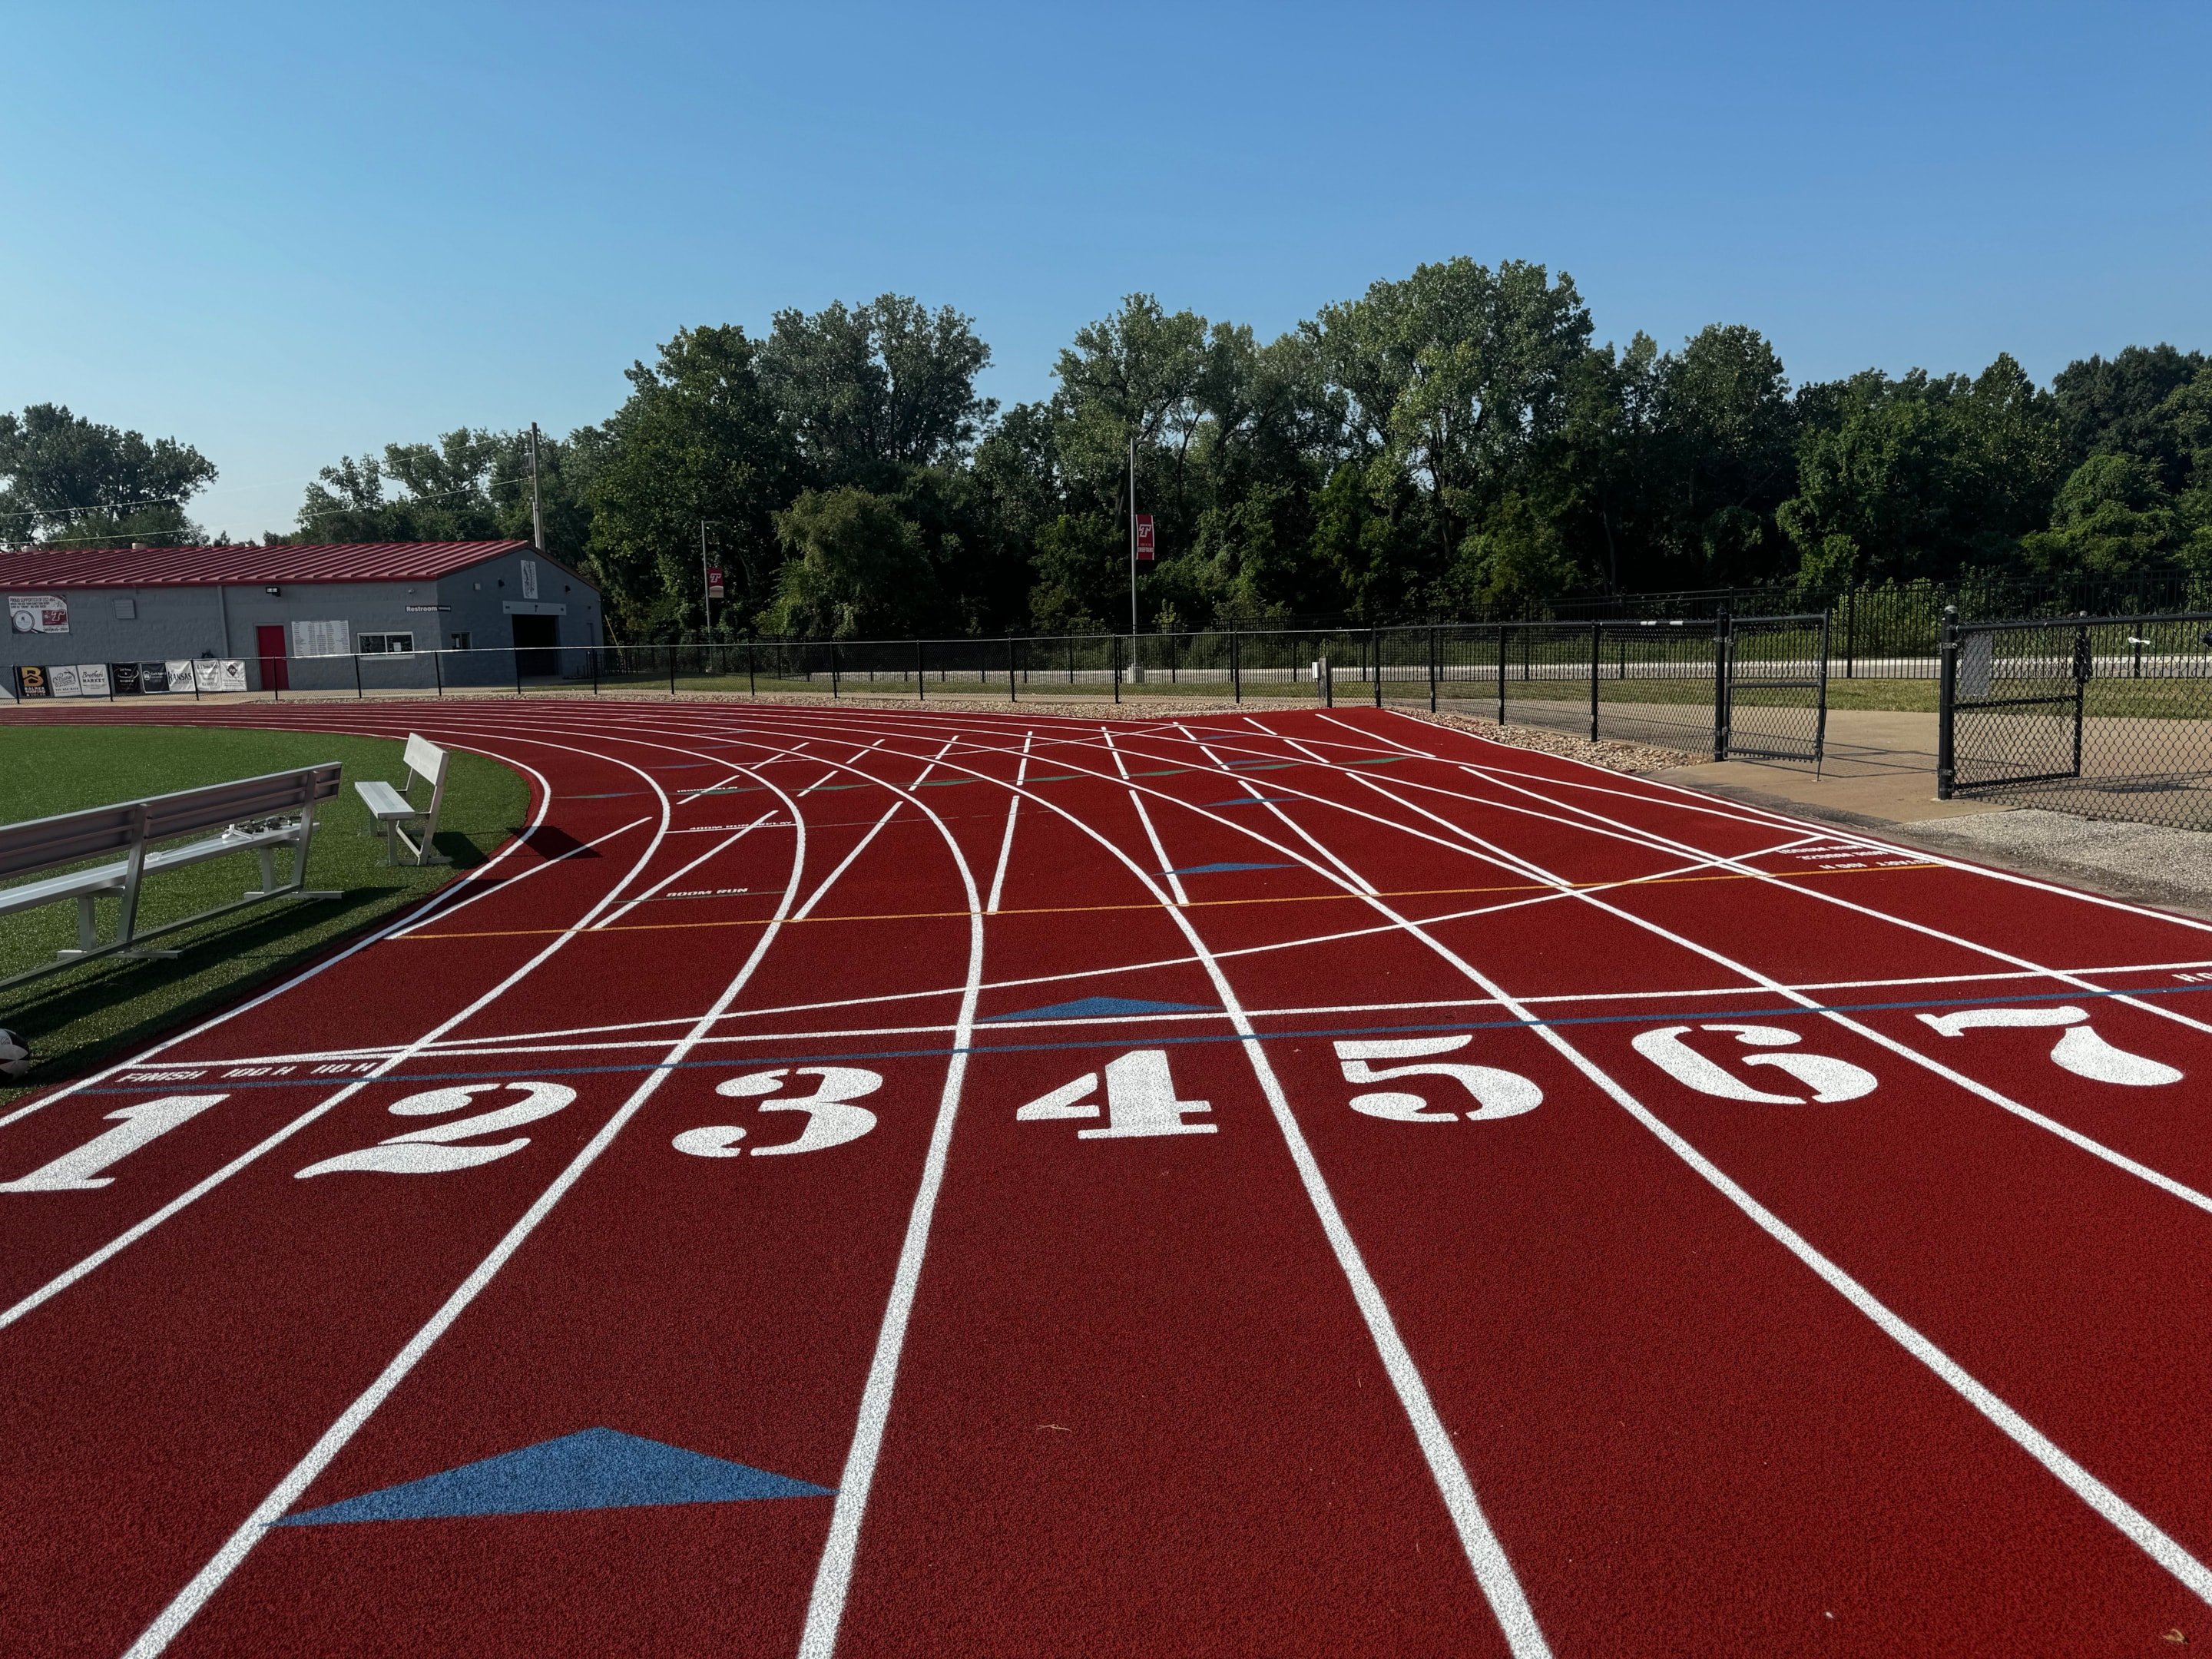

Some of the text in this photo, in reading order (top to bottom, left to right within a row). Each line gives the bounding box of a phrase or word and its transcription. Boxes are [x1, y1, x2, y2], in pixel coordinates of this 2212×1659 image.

[115, 1062, 377, 1083] FINISH 100 H 110 H
[1332, 1034, 1544, 1122] 5
[1631, 1024, 1878, 1104] 6
[1915, 1005, 2185, 1086] 7
[294, 1081, 577, 1178] 2
[672, 1067, 883, 1157] 3
[1016, 1050, 1217, 1139] 4
[0, 1094, 230, 1192] 1
